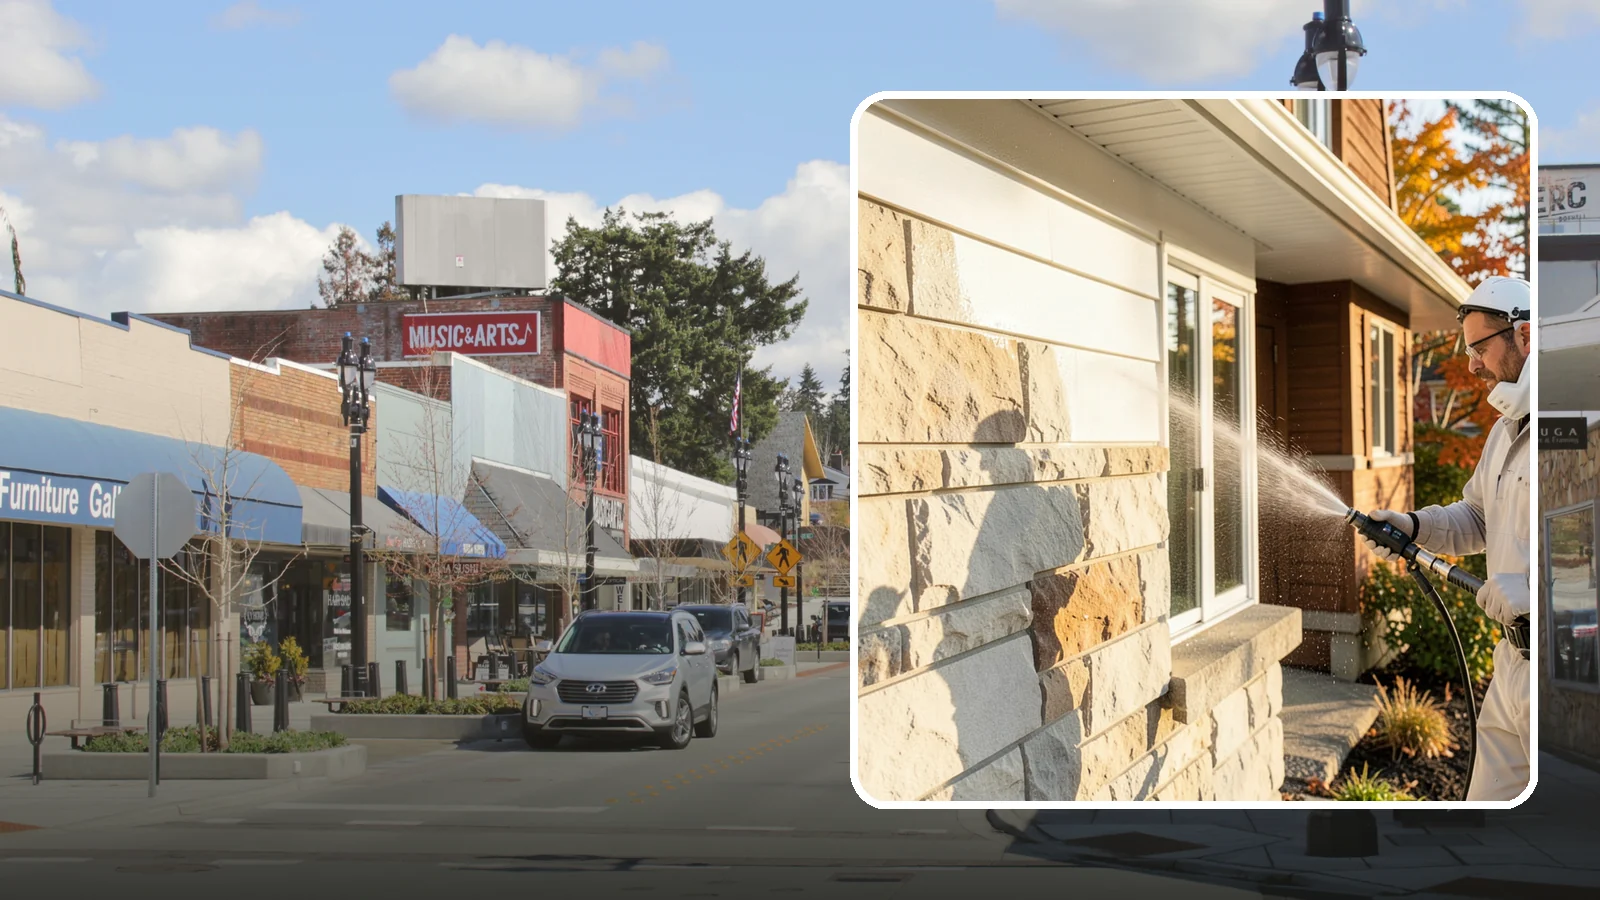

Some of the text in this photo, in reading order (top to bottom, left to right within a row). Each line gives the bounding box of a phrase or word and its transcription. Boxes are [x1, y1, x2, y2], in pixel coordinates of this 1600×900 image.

[409, 323, 520, 348] MUSIC&ARTS
[0, 471, 122, 519] Furniture Gal
